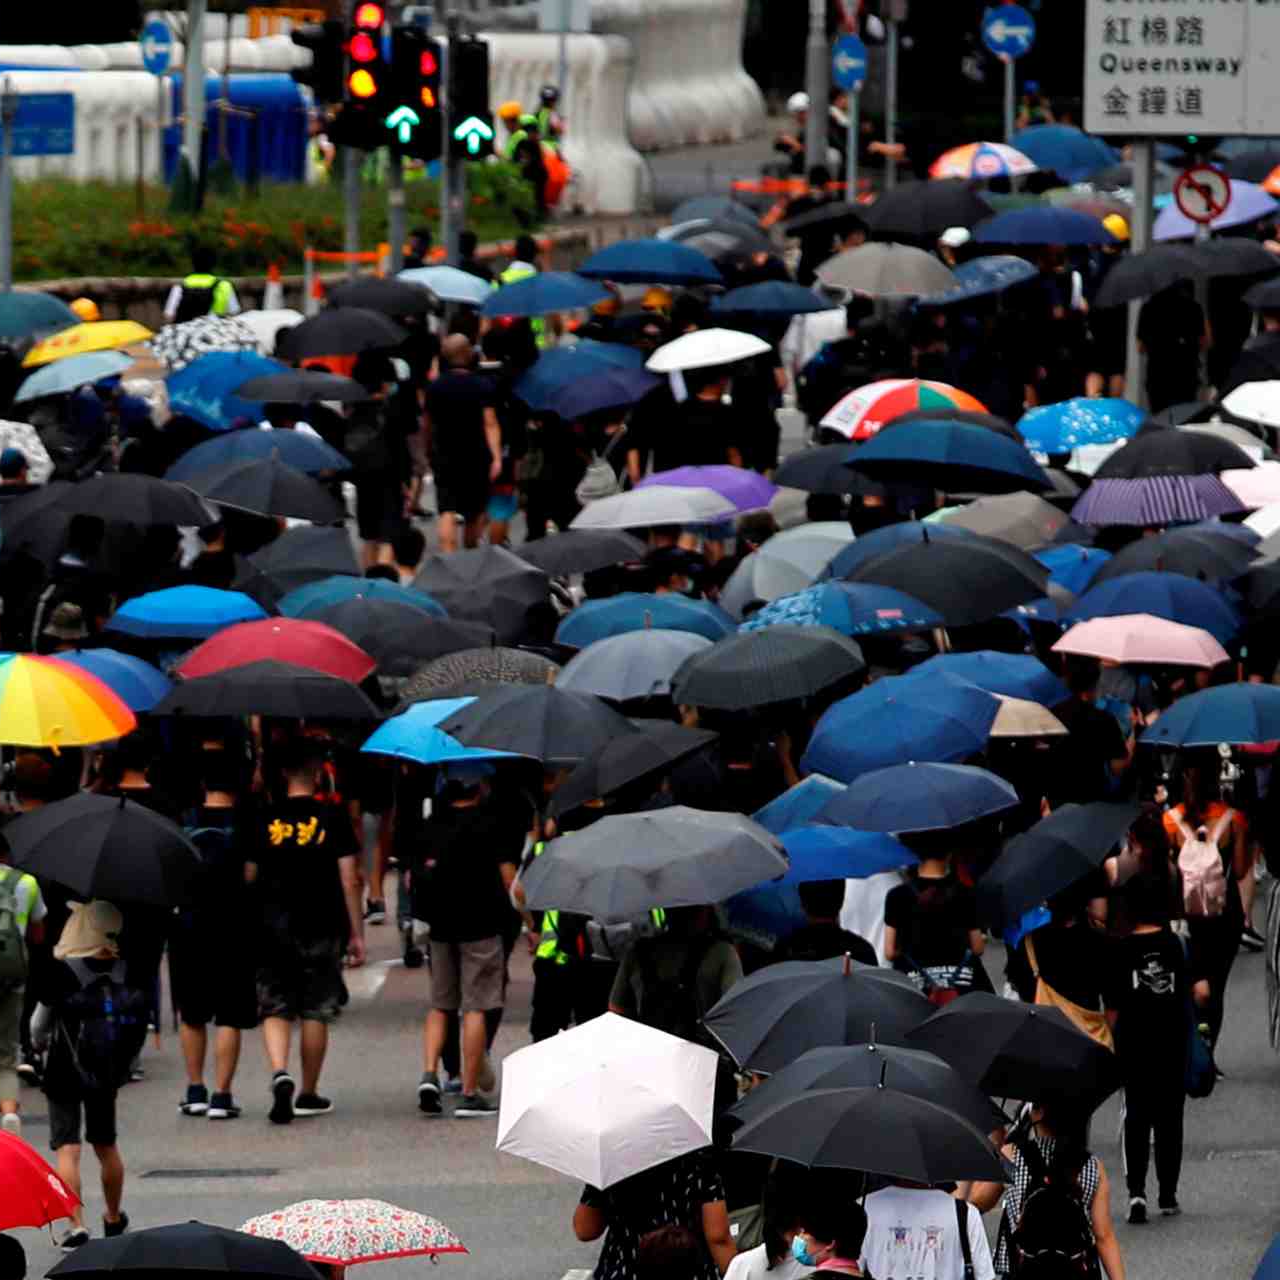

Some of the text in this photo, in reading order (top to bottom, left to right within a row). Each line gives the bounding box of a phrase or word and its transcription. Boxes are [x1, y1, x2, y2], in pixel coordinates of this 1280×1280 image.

[1104, 16, 1203, 45] 紅棉路
[1100, 53, 1241, 76] Queensway
[1104, 85, 1203, 115] 金鐘道
